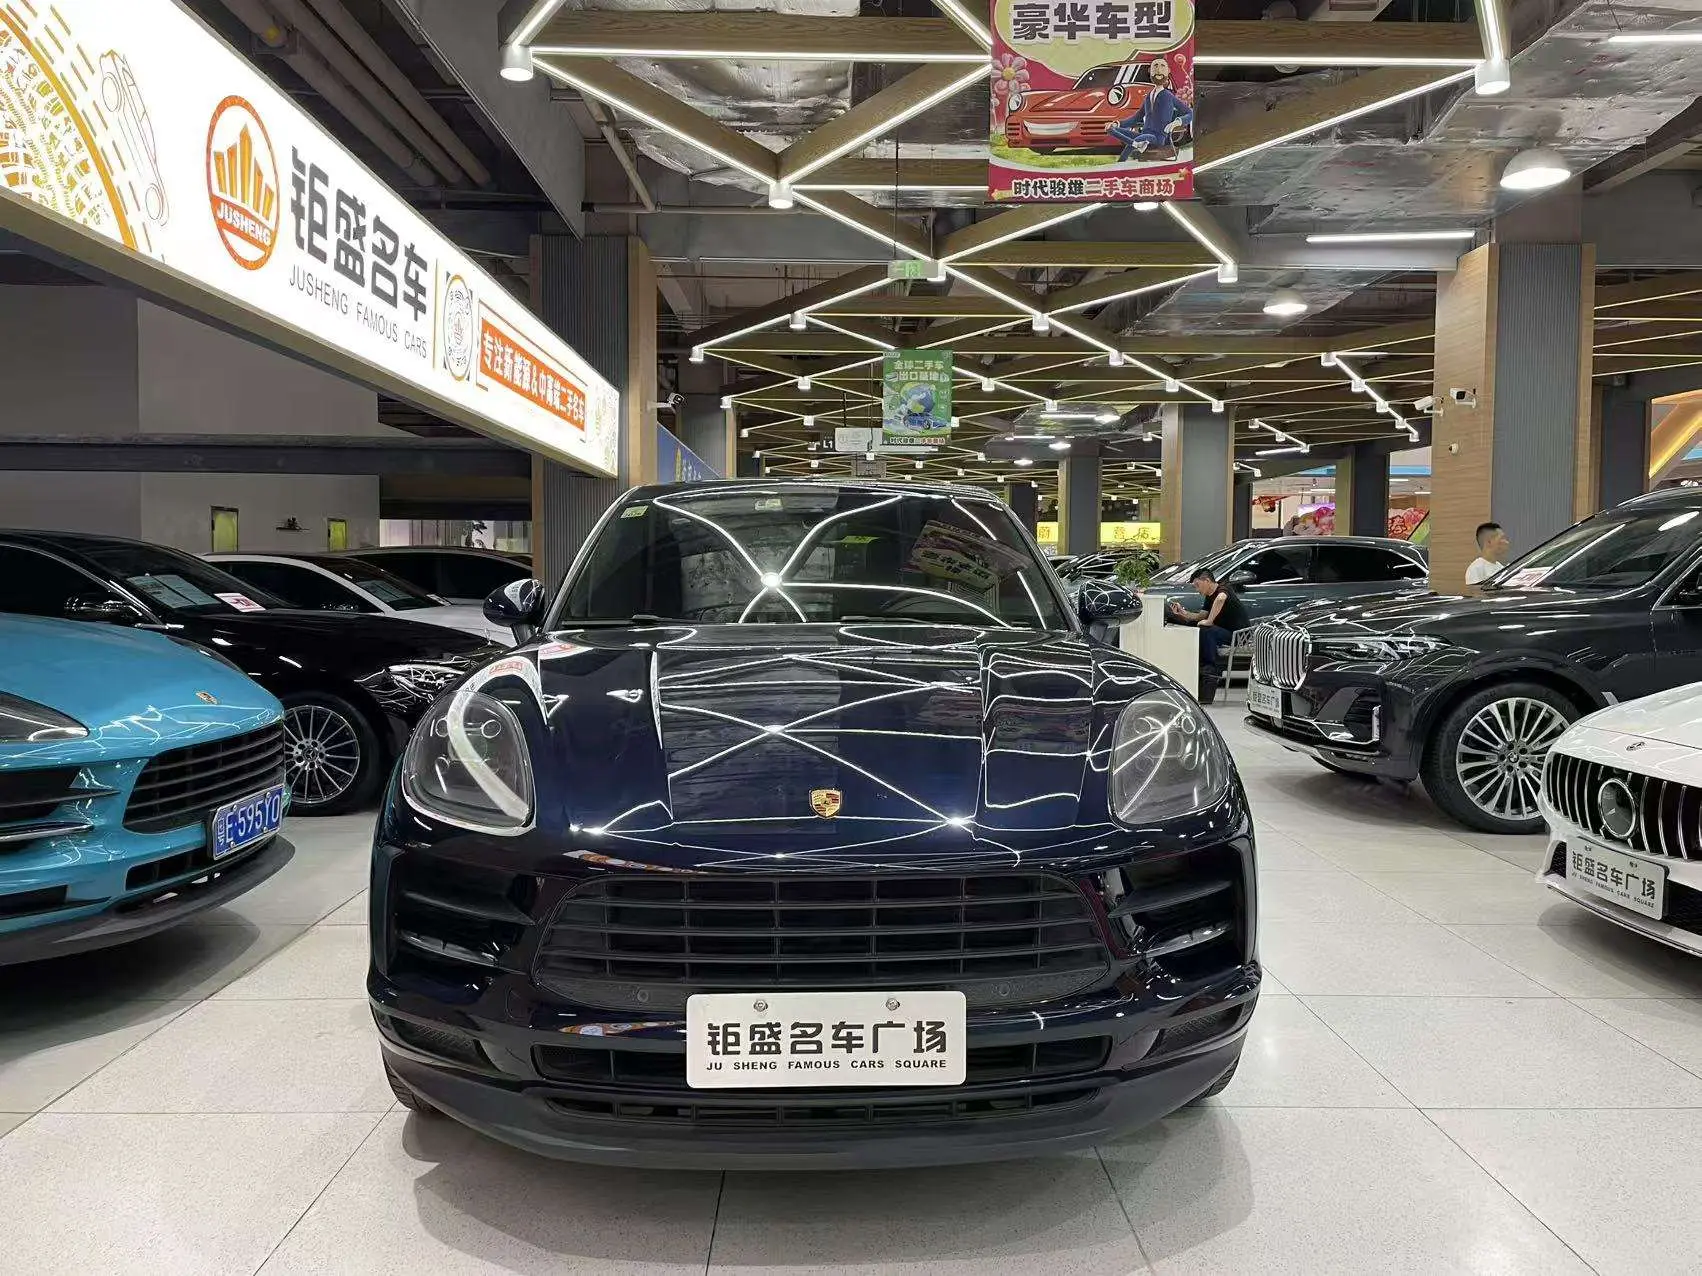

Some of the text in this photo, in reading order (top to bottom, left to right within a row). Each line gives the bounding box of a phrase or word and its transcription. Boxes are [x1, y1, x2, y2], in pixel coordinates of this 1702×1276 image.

[1013, 1, 1171, 40] 豪华车型
[1013, 178, 1175, 197] 时代骏雄二手车商场
[216, 205, 271, 245] JUSHENG
[291, 145, 428, 322] 钜盛名车
[289, 264, 349, 315] JUSHENG
[356, 302, 398, 343] FAMOUS
[404, 330, 428, 359] CARS
[1572, 850, 1655, 900] 钜盛名车广场
[1633, 896, 1655, 908] SQUARE
[707, 1020, 947, 1056] 钜盛名车广场
[706, 1059, 947, 1071] JU SHENG FAMOUS CARS SQUARE
